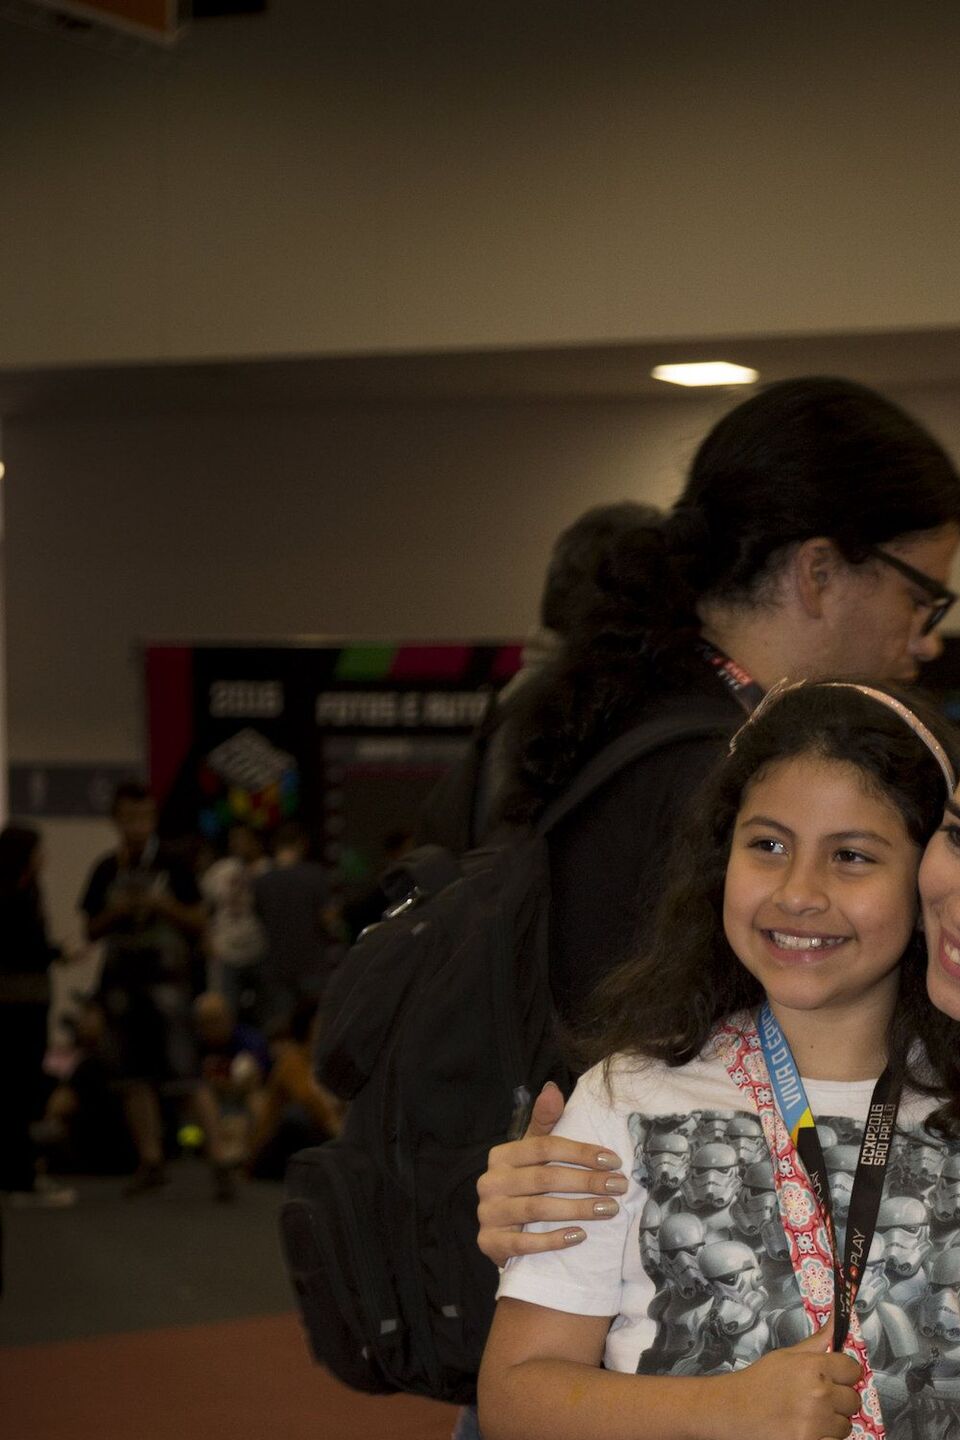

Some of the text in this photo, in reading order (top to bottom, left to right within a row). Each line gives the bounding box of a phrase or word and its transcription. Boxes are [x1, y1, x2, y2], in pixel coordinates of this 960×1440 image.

[775, 1063, 802, 1110] VIVA
[860, 1103, 884, 1165] CCXP2016
[850, 1228, 866, 1267] PLAY
